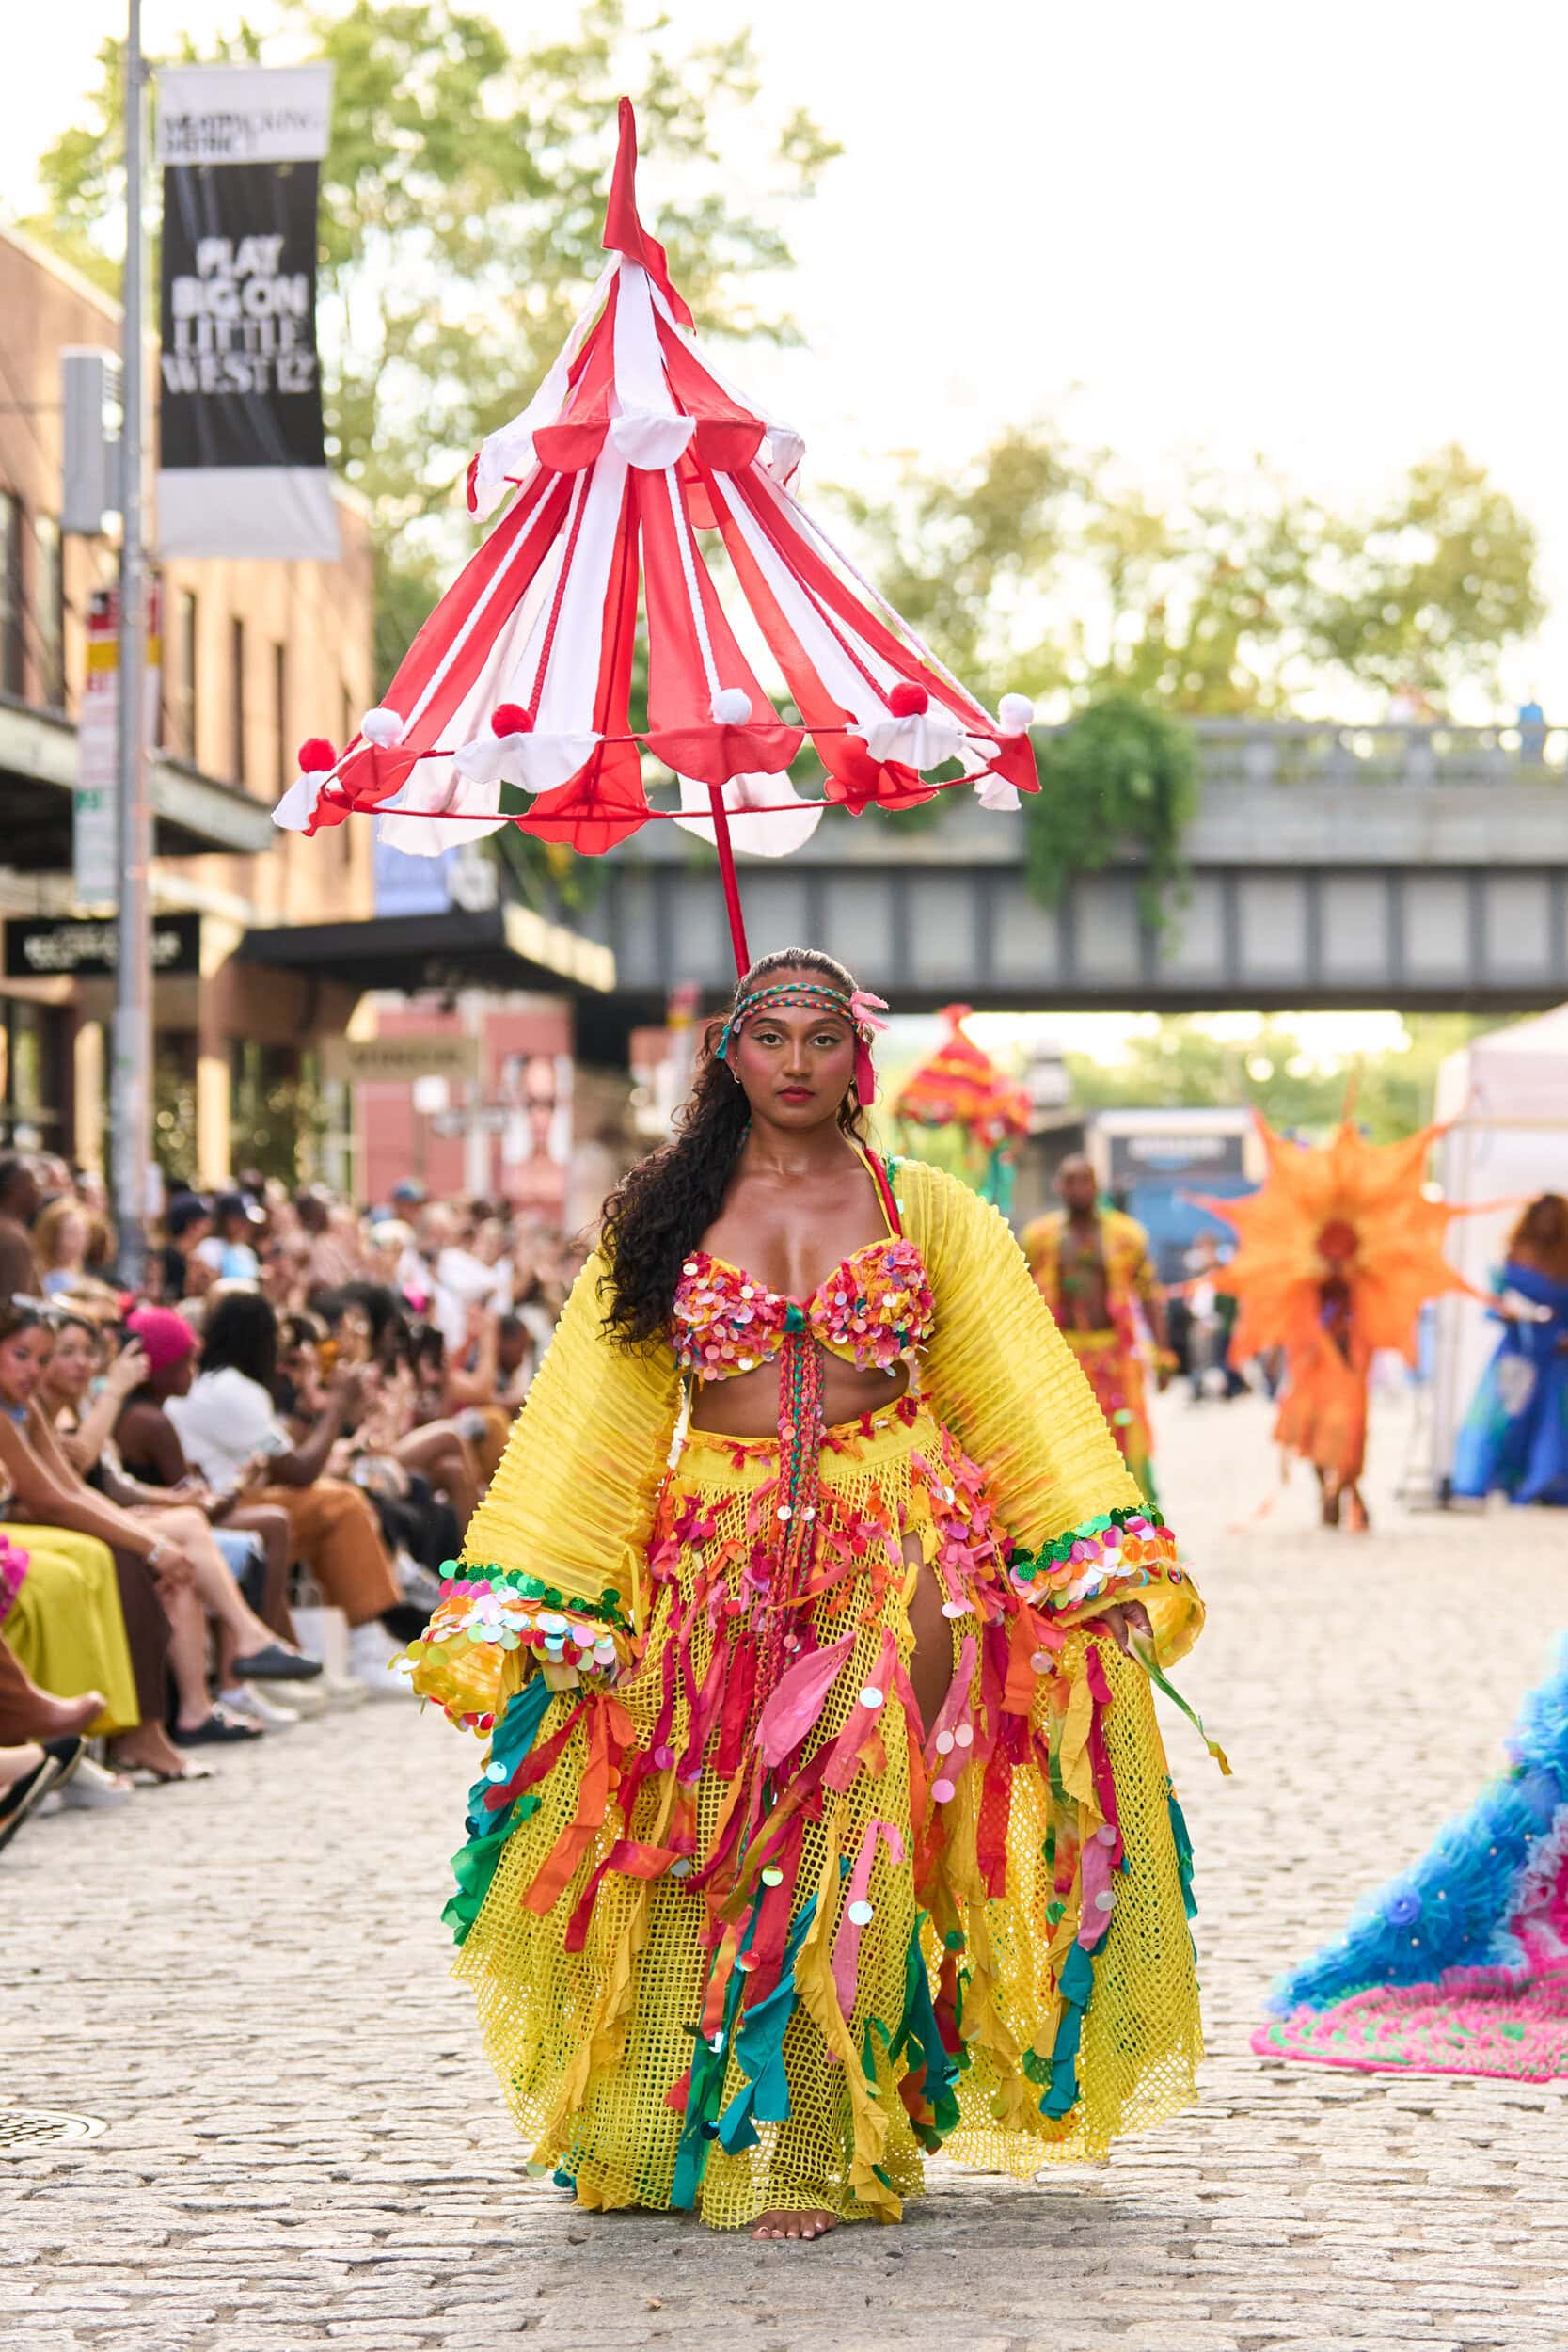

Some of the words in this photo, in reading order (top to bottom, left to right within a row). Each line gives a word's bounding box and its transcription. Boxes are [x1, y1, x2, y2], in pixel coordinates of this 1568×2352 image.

[196, 234, 284, 278] PLAY
[171, 276, 242, 319] BIG
[242, 273, 309, 318] ON
[174, 317, 308, 357] LITTLE
[161, 352, 273, 394] WEST
[277, 351, 318, 394] 12
